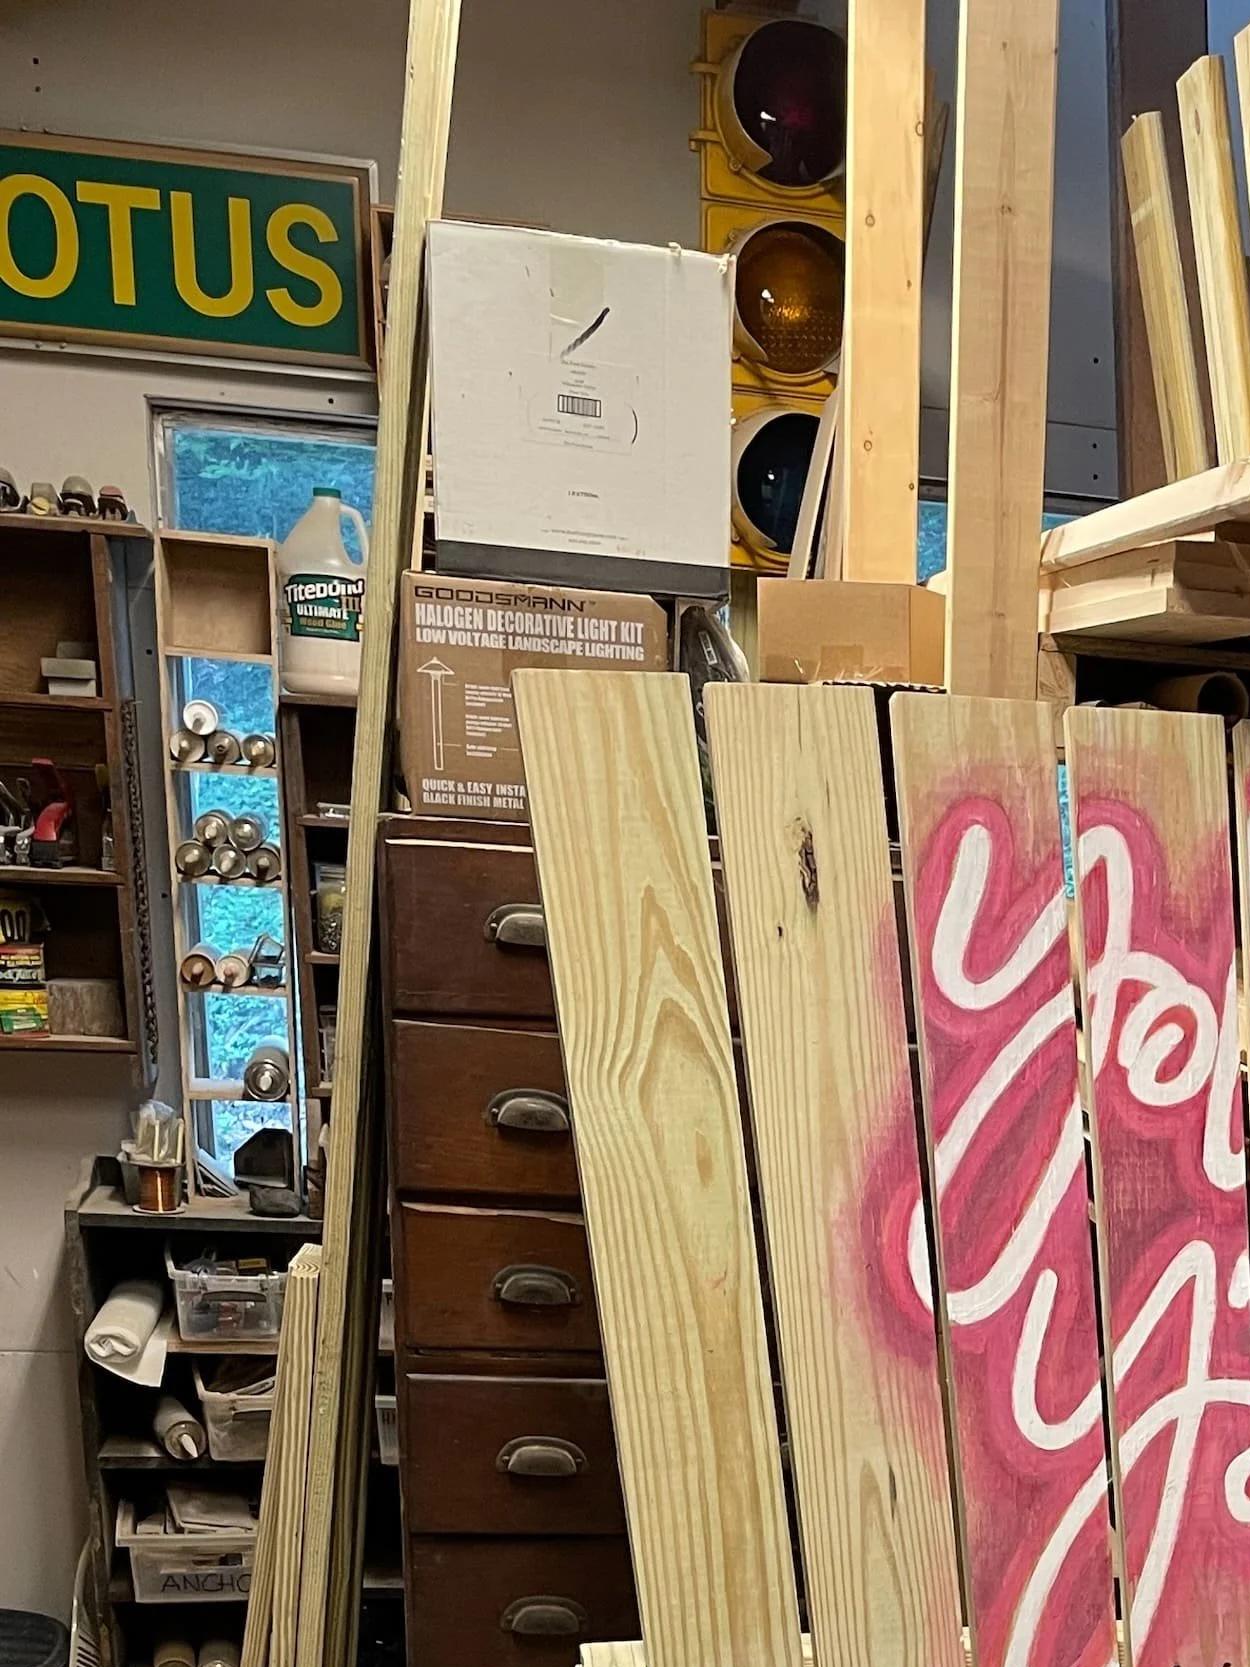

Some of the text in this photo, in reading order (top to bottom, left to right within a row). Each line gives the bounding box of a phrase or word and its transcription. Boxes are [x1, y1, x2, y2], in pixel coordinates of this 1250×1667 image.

[0, 174, 343, 327] OTUS
[414, 586, 585, 612] GOODSMANN
[296, 603, 349, 620] ULTIMATE
[415, 602, 644, 645] HALOGEN DECORATIVE LIGHT KIT
[416, 627, 644, 662] LOW VOLTAGE LANDSCAPE LIGHTING
[422, 778, 455, 792] QUICK
[457, 782, 465, 793] &
[467, 781, 492, 795] EASY
[423, 791, 525, 810] BLACK FINISH METAL
[161, 1573, 252, 1593] ANCHO
